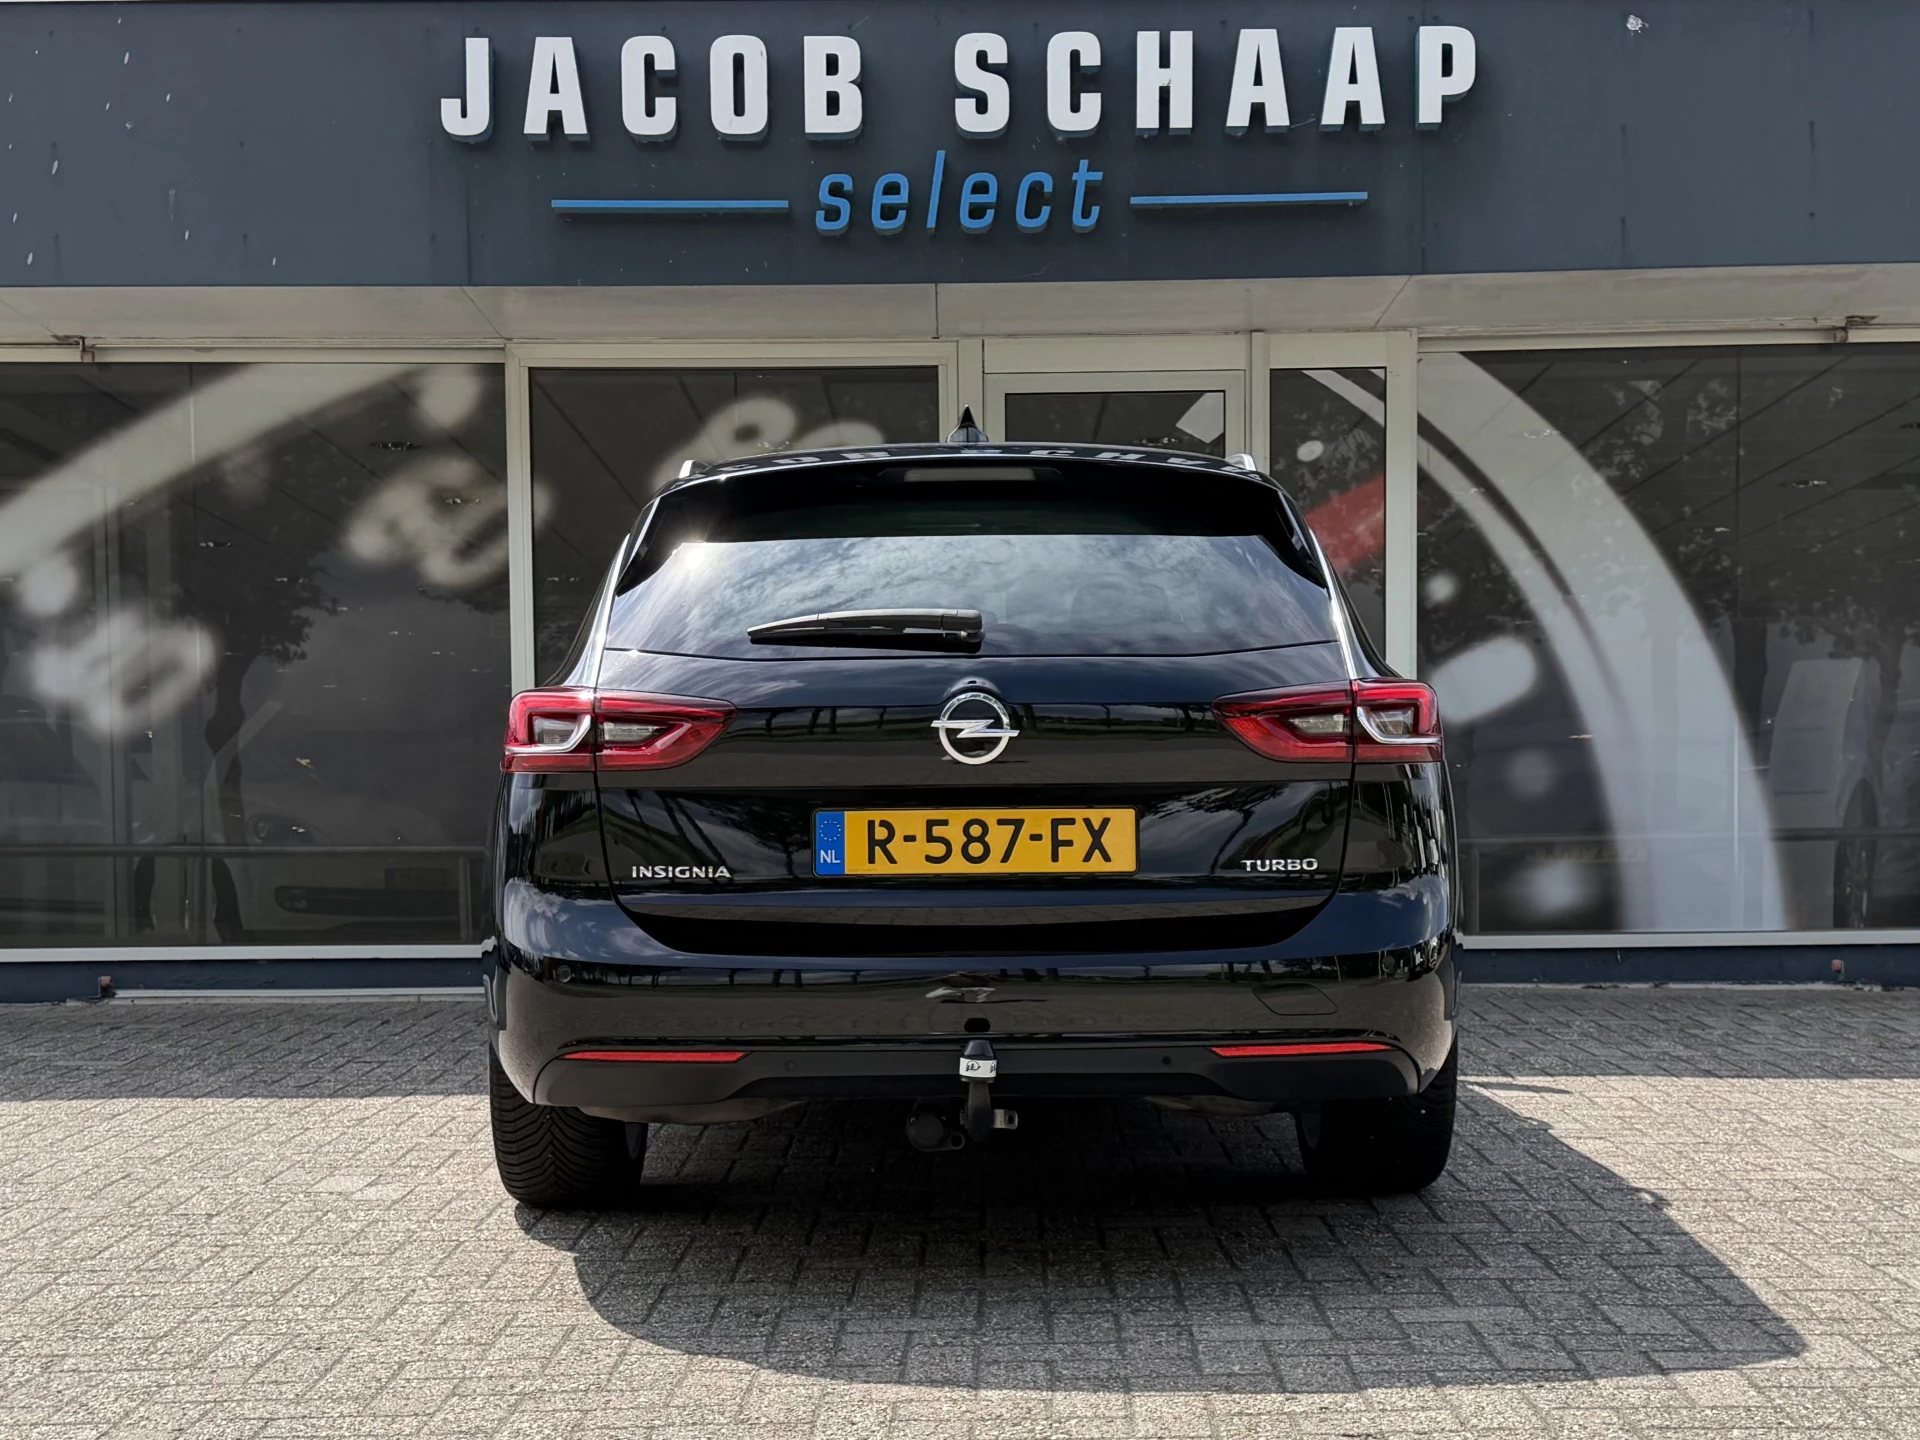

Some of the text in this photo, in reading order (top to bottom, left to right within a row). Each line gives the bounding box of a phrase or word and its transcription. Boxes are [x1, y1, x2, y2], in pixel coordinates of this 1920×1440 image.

[441, 25, 1476, 139] JACOB SCHAAP
[815, 150, 1103, 233] select
[819, 849, 840, 864] NL
[866, 817, 1112, 865] R-587-FX
[631, 865, 732, 878] INSIGNIA
[1240, 858, 1319, 872] TURBO
